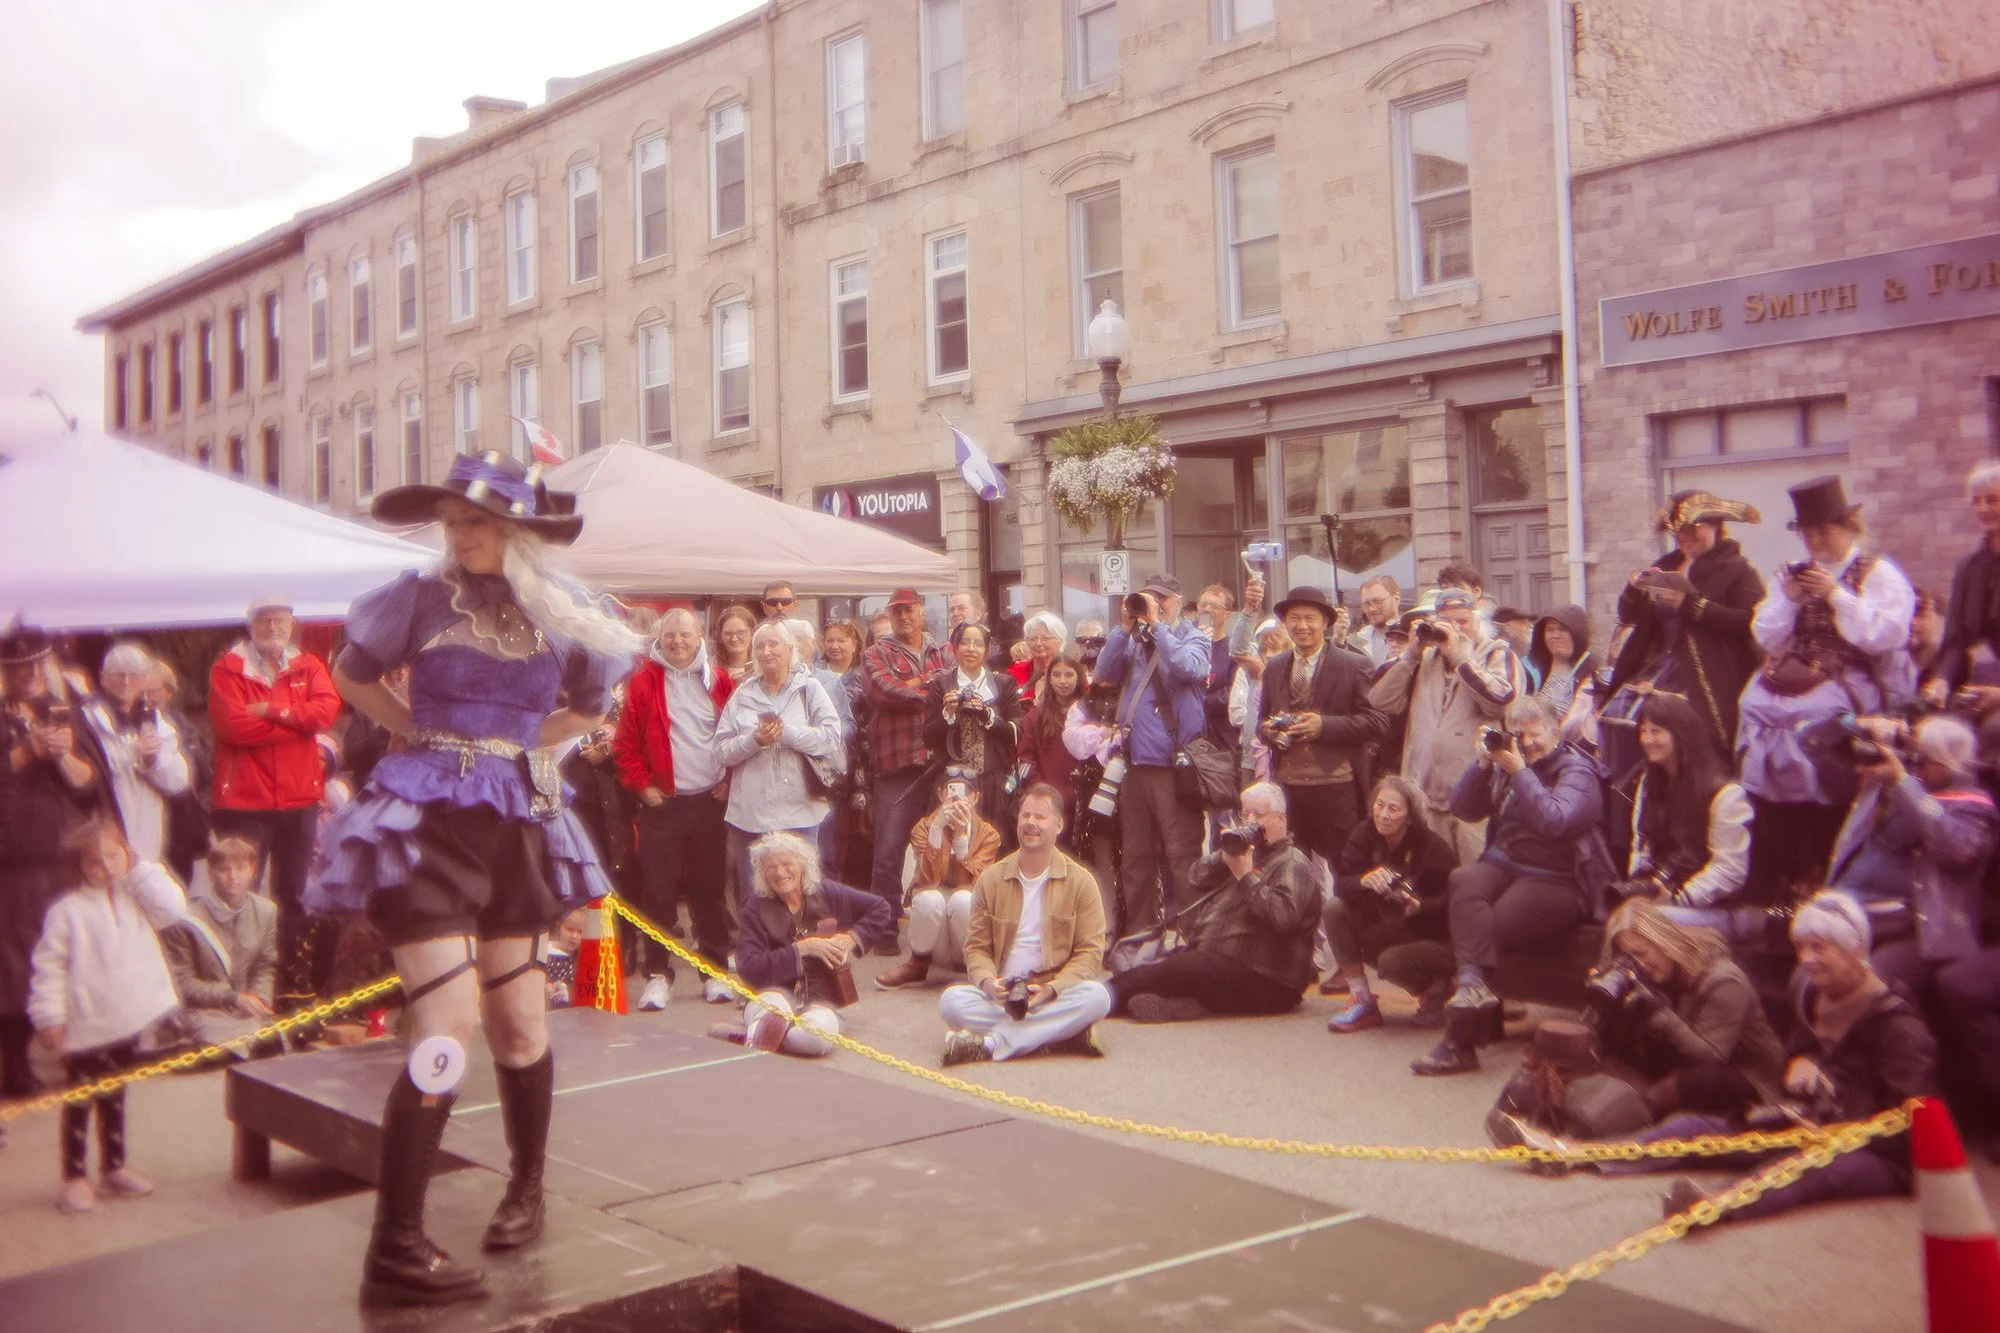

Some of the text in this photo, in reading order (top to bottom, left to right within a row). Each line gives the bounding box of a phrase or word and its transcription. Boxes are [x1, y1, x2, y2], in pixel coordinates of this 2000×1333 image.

[1620, 305, 1723, 341] WOLFE
[1744, 283, 1858, 324] SMITH
[1884, 277, 1907, 303] &
[857, 491, 928, 516] YOUTOPIA
[1111, 558, 1120, 568] P
[431, 1052, 449, 1078] 9
